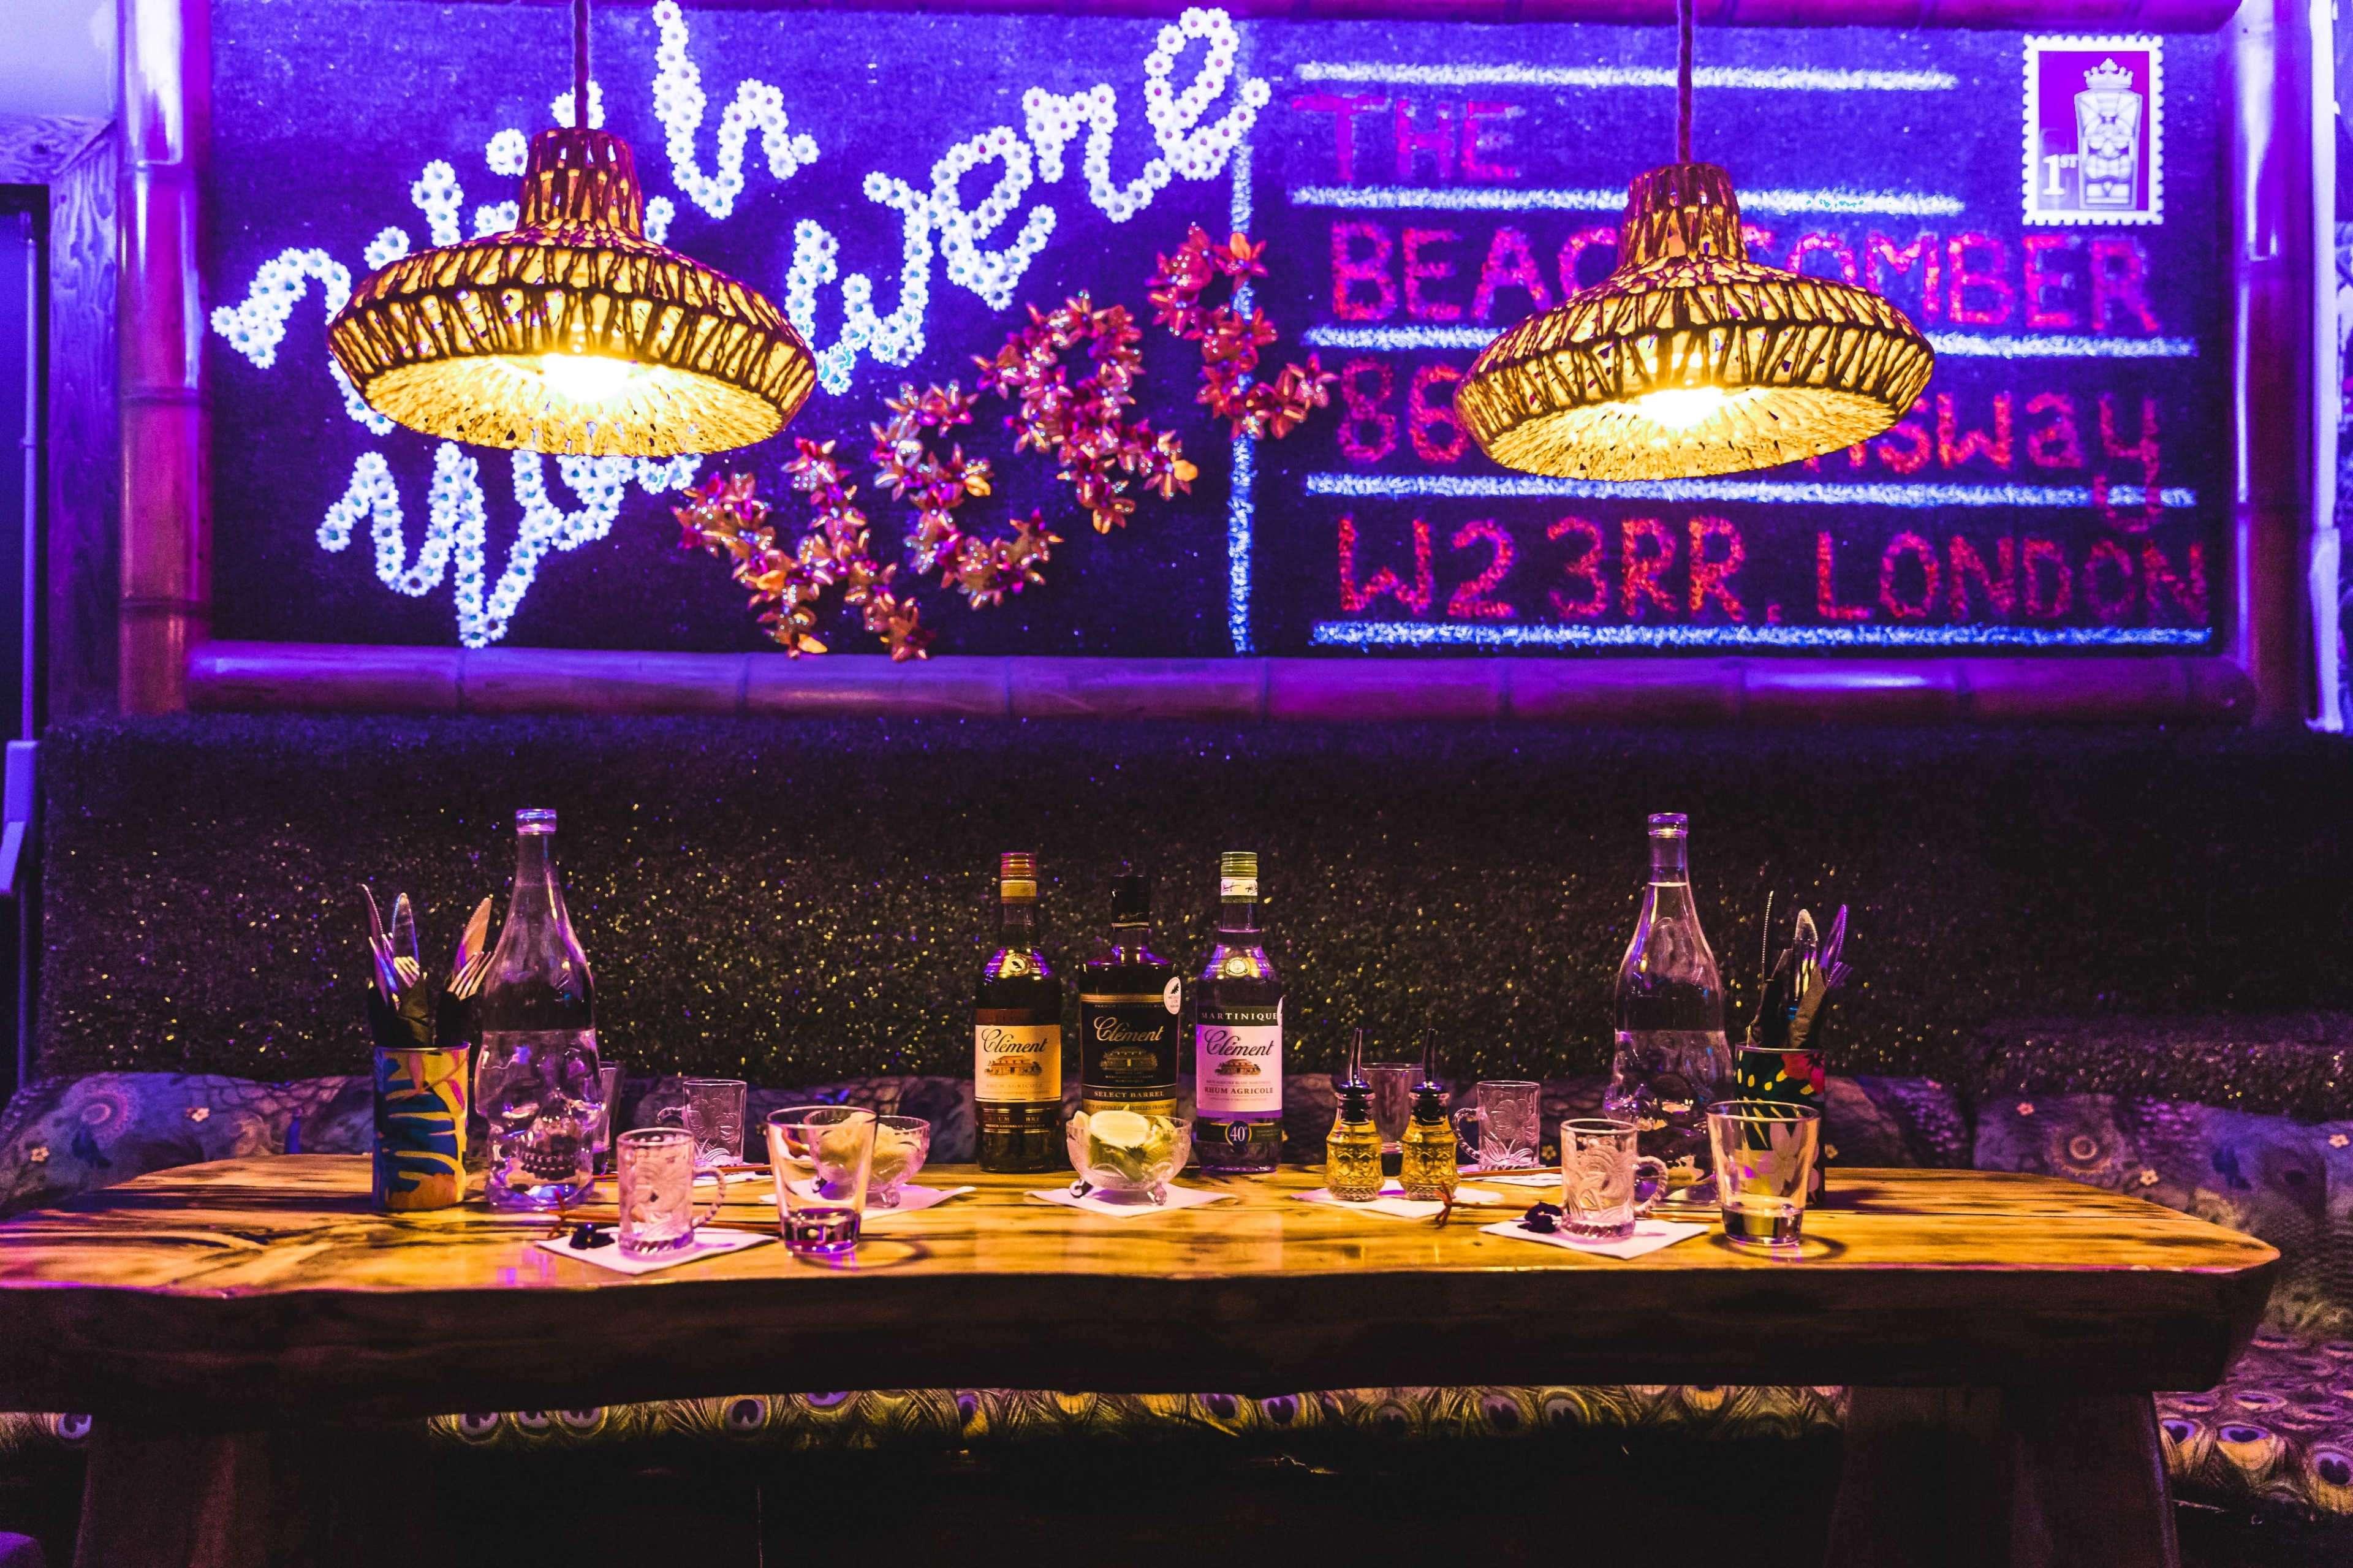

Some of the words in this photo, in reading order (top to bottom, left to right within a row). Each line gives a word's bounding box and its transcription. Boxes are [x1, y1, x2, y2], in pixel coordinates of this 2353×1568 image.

[1292, 93, 1523, 182] THE
[2042, 153, 2078, 196] 1ST
[1330, 219, 2161, 333] BEACOMBER
[1337, 357, 1471, 464] 86
[1815, 529, 2210, 626] LONDON
[1093, 1016, 1164, 1042] Clément
[1201, 1012, 1277, 1021] MARTINIQUE
[982, 1029, 1048, 1053] Clément
[1204, 1029, 1275, 1056] Clément
[1093, 1090, 1127, 1099] SELECT
[1130, 1089, 1165, 1099] BARREL
[1204, 1086, 1229, 1094] RHUM
